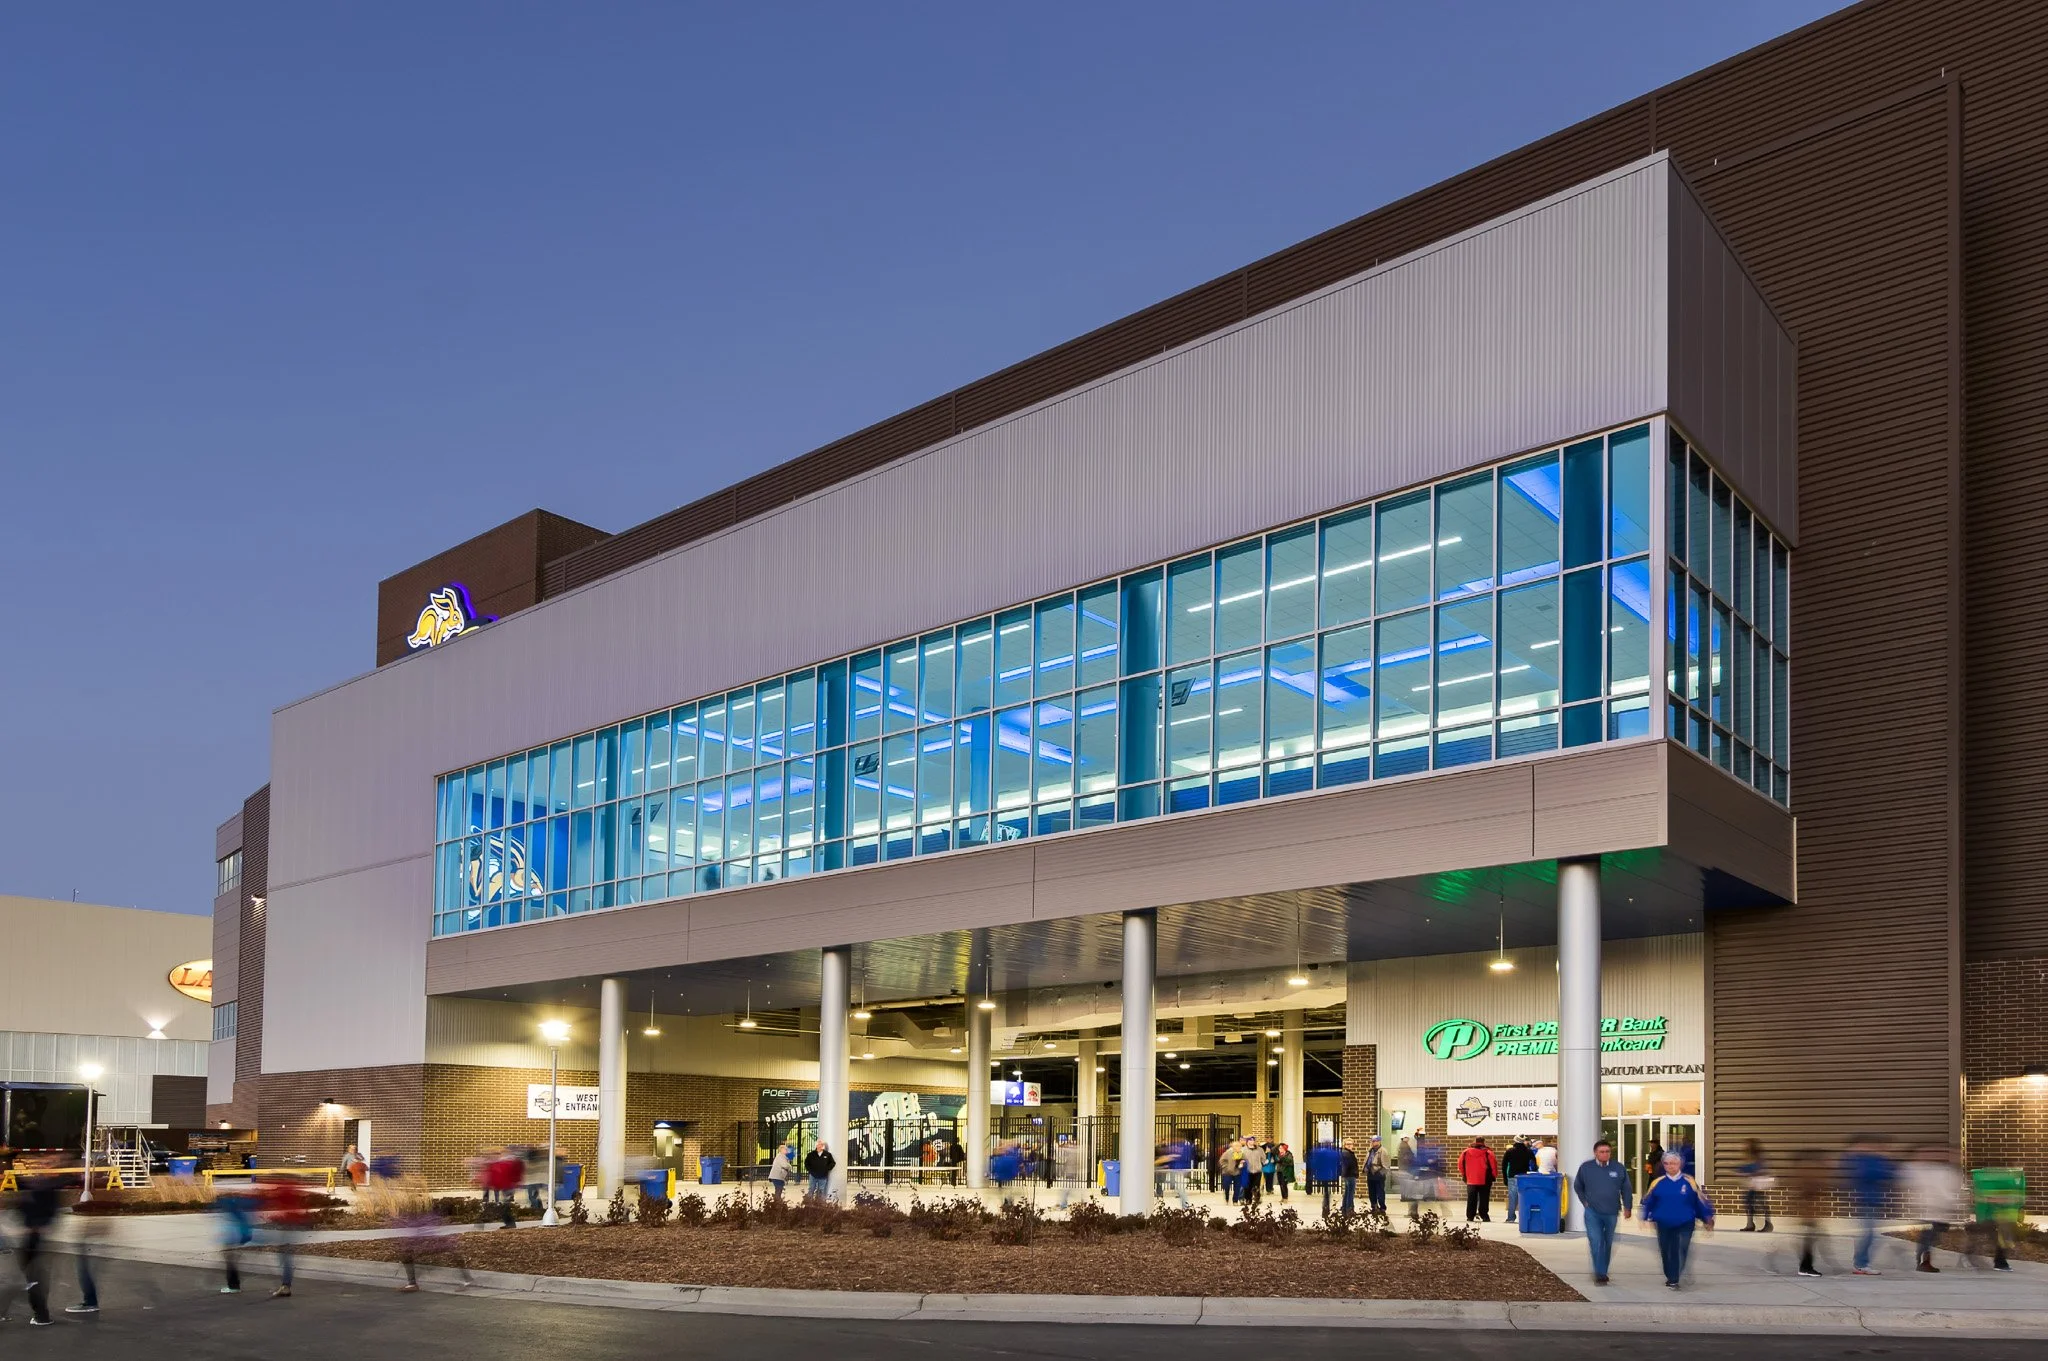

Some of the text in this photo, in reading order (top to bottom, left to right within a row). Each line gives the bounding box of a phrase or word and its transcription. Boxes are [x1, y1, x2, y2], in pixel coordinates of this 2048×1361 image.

[177, 967, 213, 988] LA
[1493, 1023, 1530, 1037] First
[1621, 1016, 1667, 1031] Bank
[1494, 1036, 1664, 1056] PREMIE nkcard
[1646, 1063, 1705, 1075] ENTRAN
[576, 1094, 598, 1102] WEST
[762, 1088, 792, 1097] POET
[565, 1102, 599, 1111] ENTRAN
[1493, 1100, 1513, 1108] SUITE
[1519, 1099, 1537, 1107] LOGE
[1544, 1099, 1558, 1107] CLU
[765, 1102, 820, 1127] PASSION NEVE
[1495, 1112, 1540, 1122] ENTRANCE
